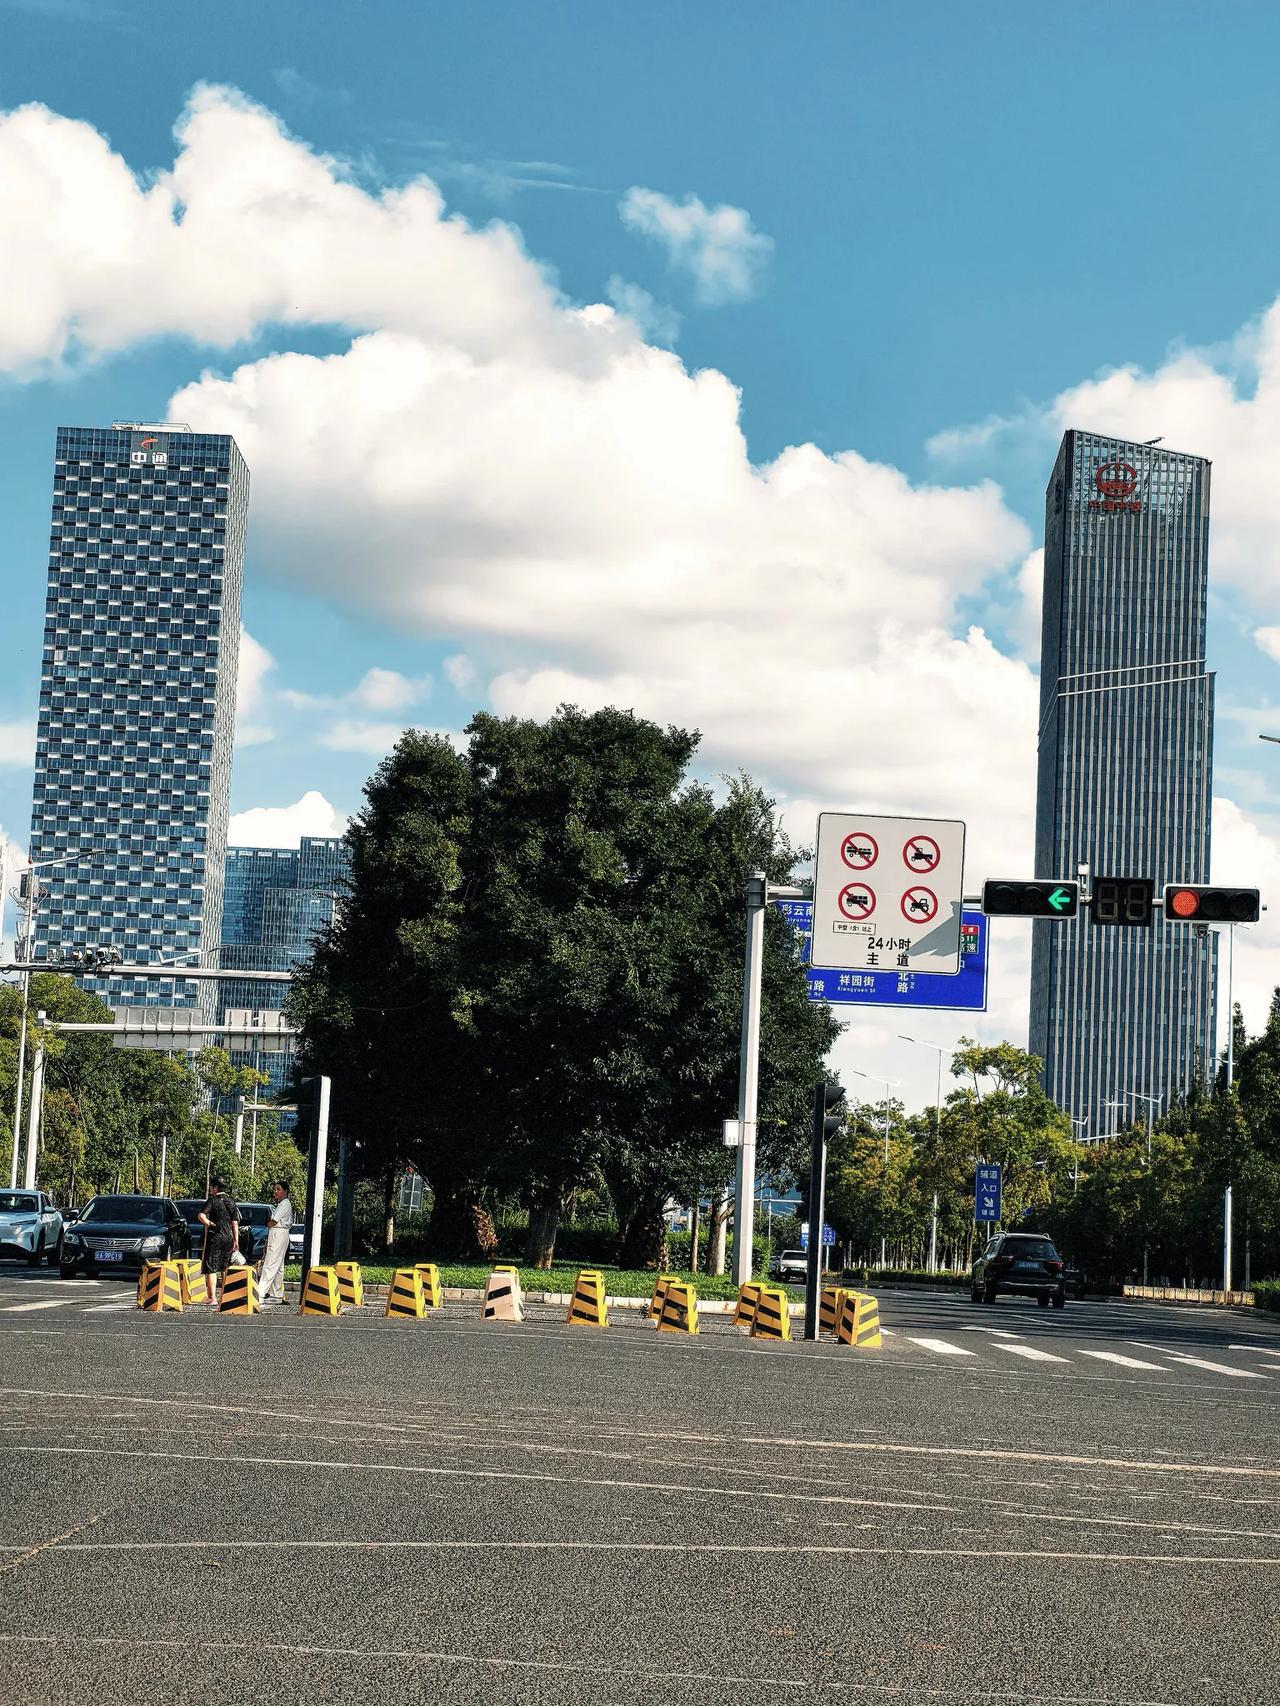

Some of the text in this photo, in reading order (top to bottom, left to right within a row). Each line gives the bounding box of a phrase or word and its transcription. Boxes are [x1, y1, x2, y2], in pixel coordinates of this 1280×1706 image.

[131, 451, 168, 465] 中通
[867, 936, 911, 951] 24小时
[839, 974, 875, 987] 祥园街
[981, 1183, 997, 1192] 入口
